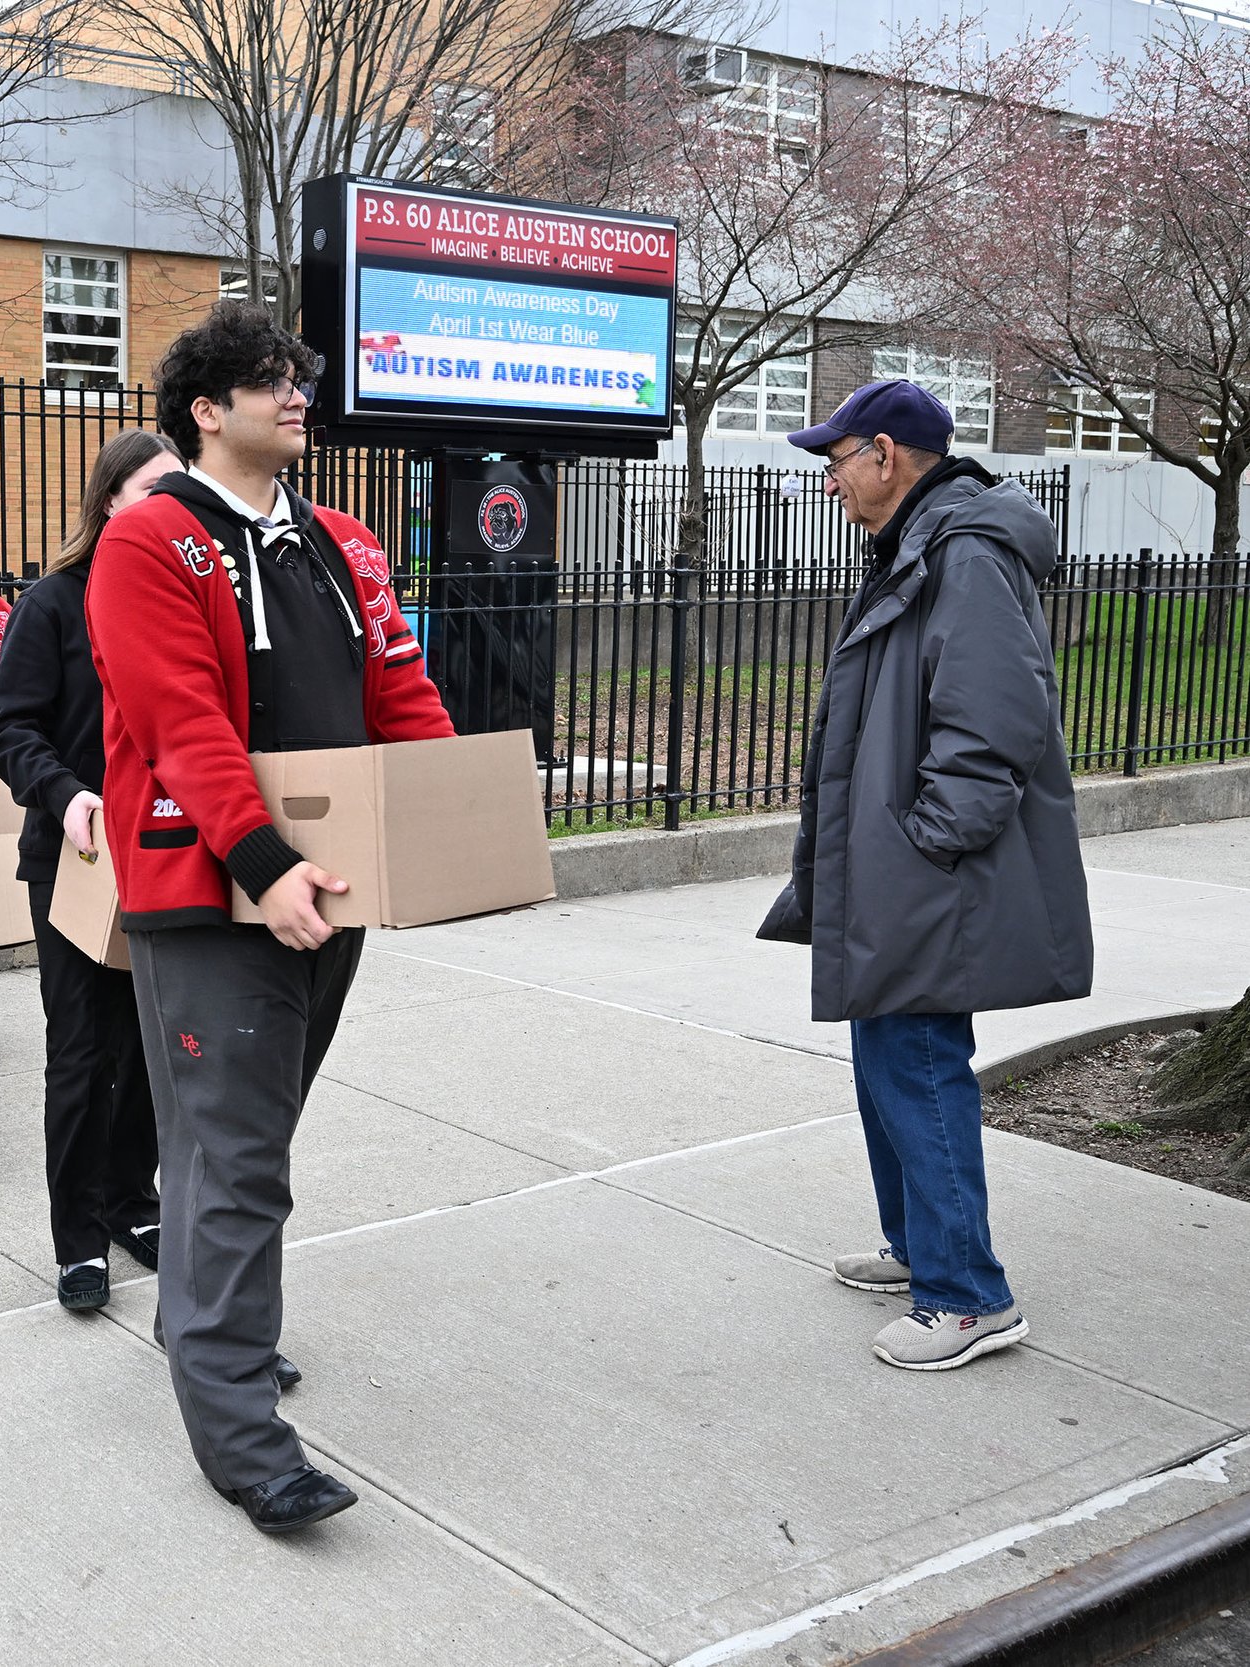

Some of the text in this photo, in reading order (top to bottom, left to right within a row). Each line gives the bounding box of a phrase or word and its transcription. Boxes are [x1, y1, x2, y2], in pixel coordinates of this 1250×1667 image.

[363, 198, 669, 258] P.S. 60 ALICE AUSTEN SCHOOL
[431, 237, 613, 273] IMAGINE BELIEVE ACHIEVE
[413, 278, 619, 323] Autism Awareness Day
[429, 312, 599, 346] April 1st Wear Blue
[372, 352, 646, 391] AUTISM AWARENESS
[170, 534, 215, 578] MC
[179, 1033, 203, 1058] MC
